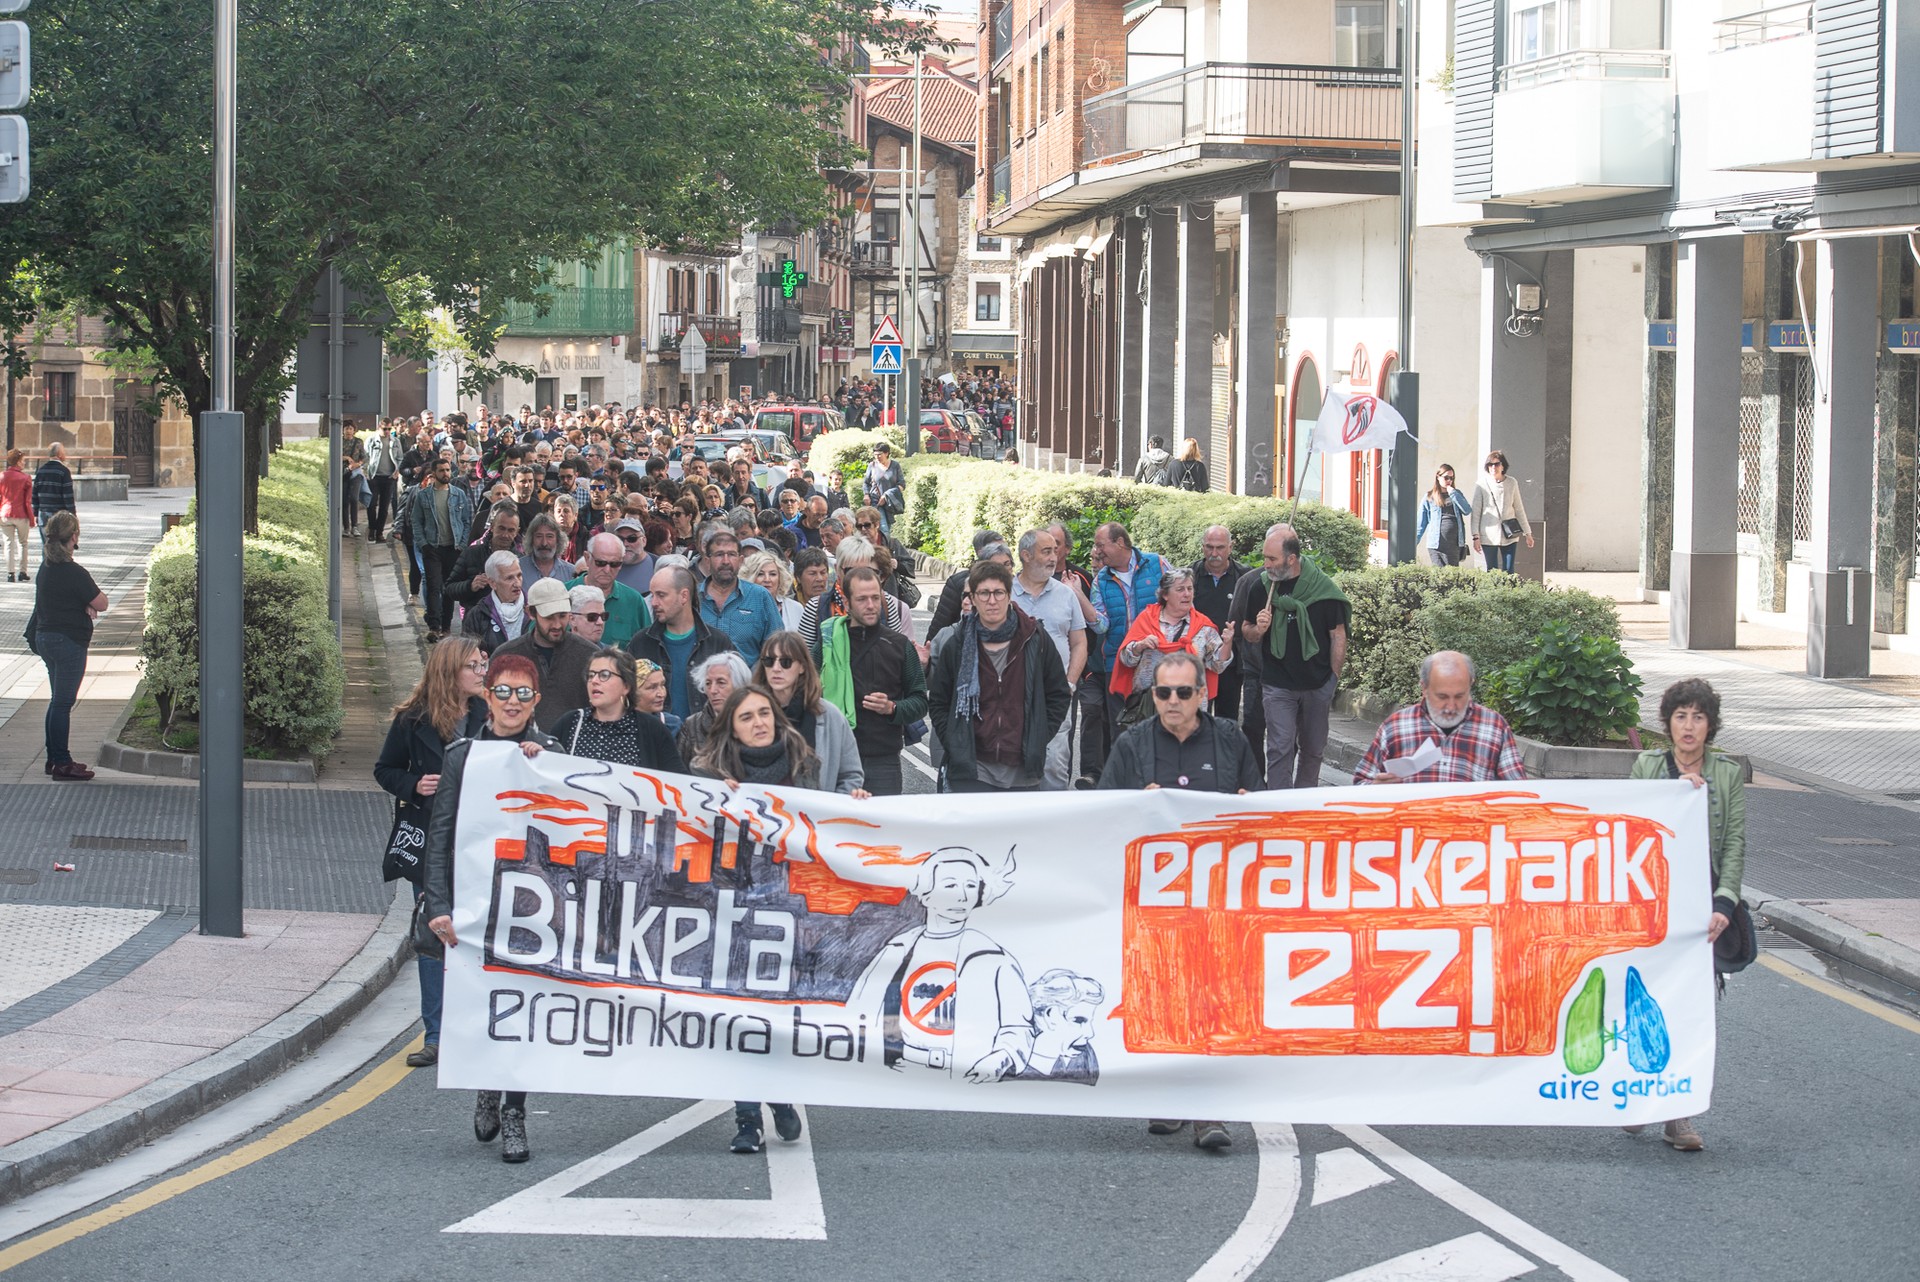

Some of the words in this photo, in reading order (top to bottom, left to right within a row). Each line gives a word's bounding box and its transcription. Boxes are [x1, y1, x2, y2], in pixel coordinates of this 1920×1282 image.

[554, 355, 571, 370] OGI
[575, 355, 600, 370] BERRI
[1138, 820, 1658, 910] errausketarik
[488, 989, 772, 1057] eraginkorra
[793, 1006, 867, 1062] bai
[1262, 925, 1496, 1054] ez!
[1539, 1074, 1599, 1100] aire
[1612, 1072, 1692, 1110] garbia
